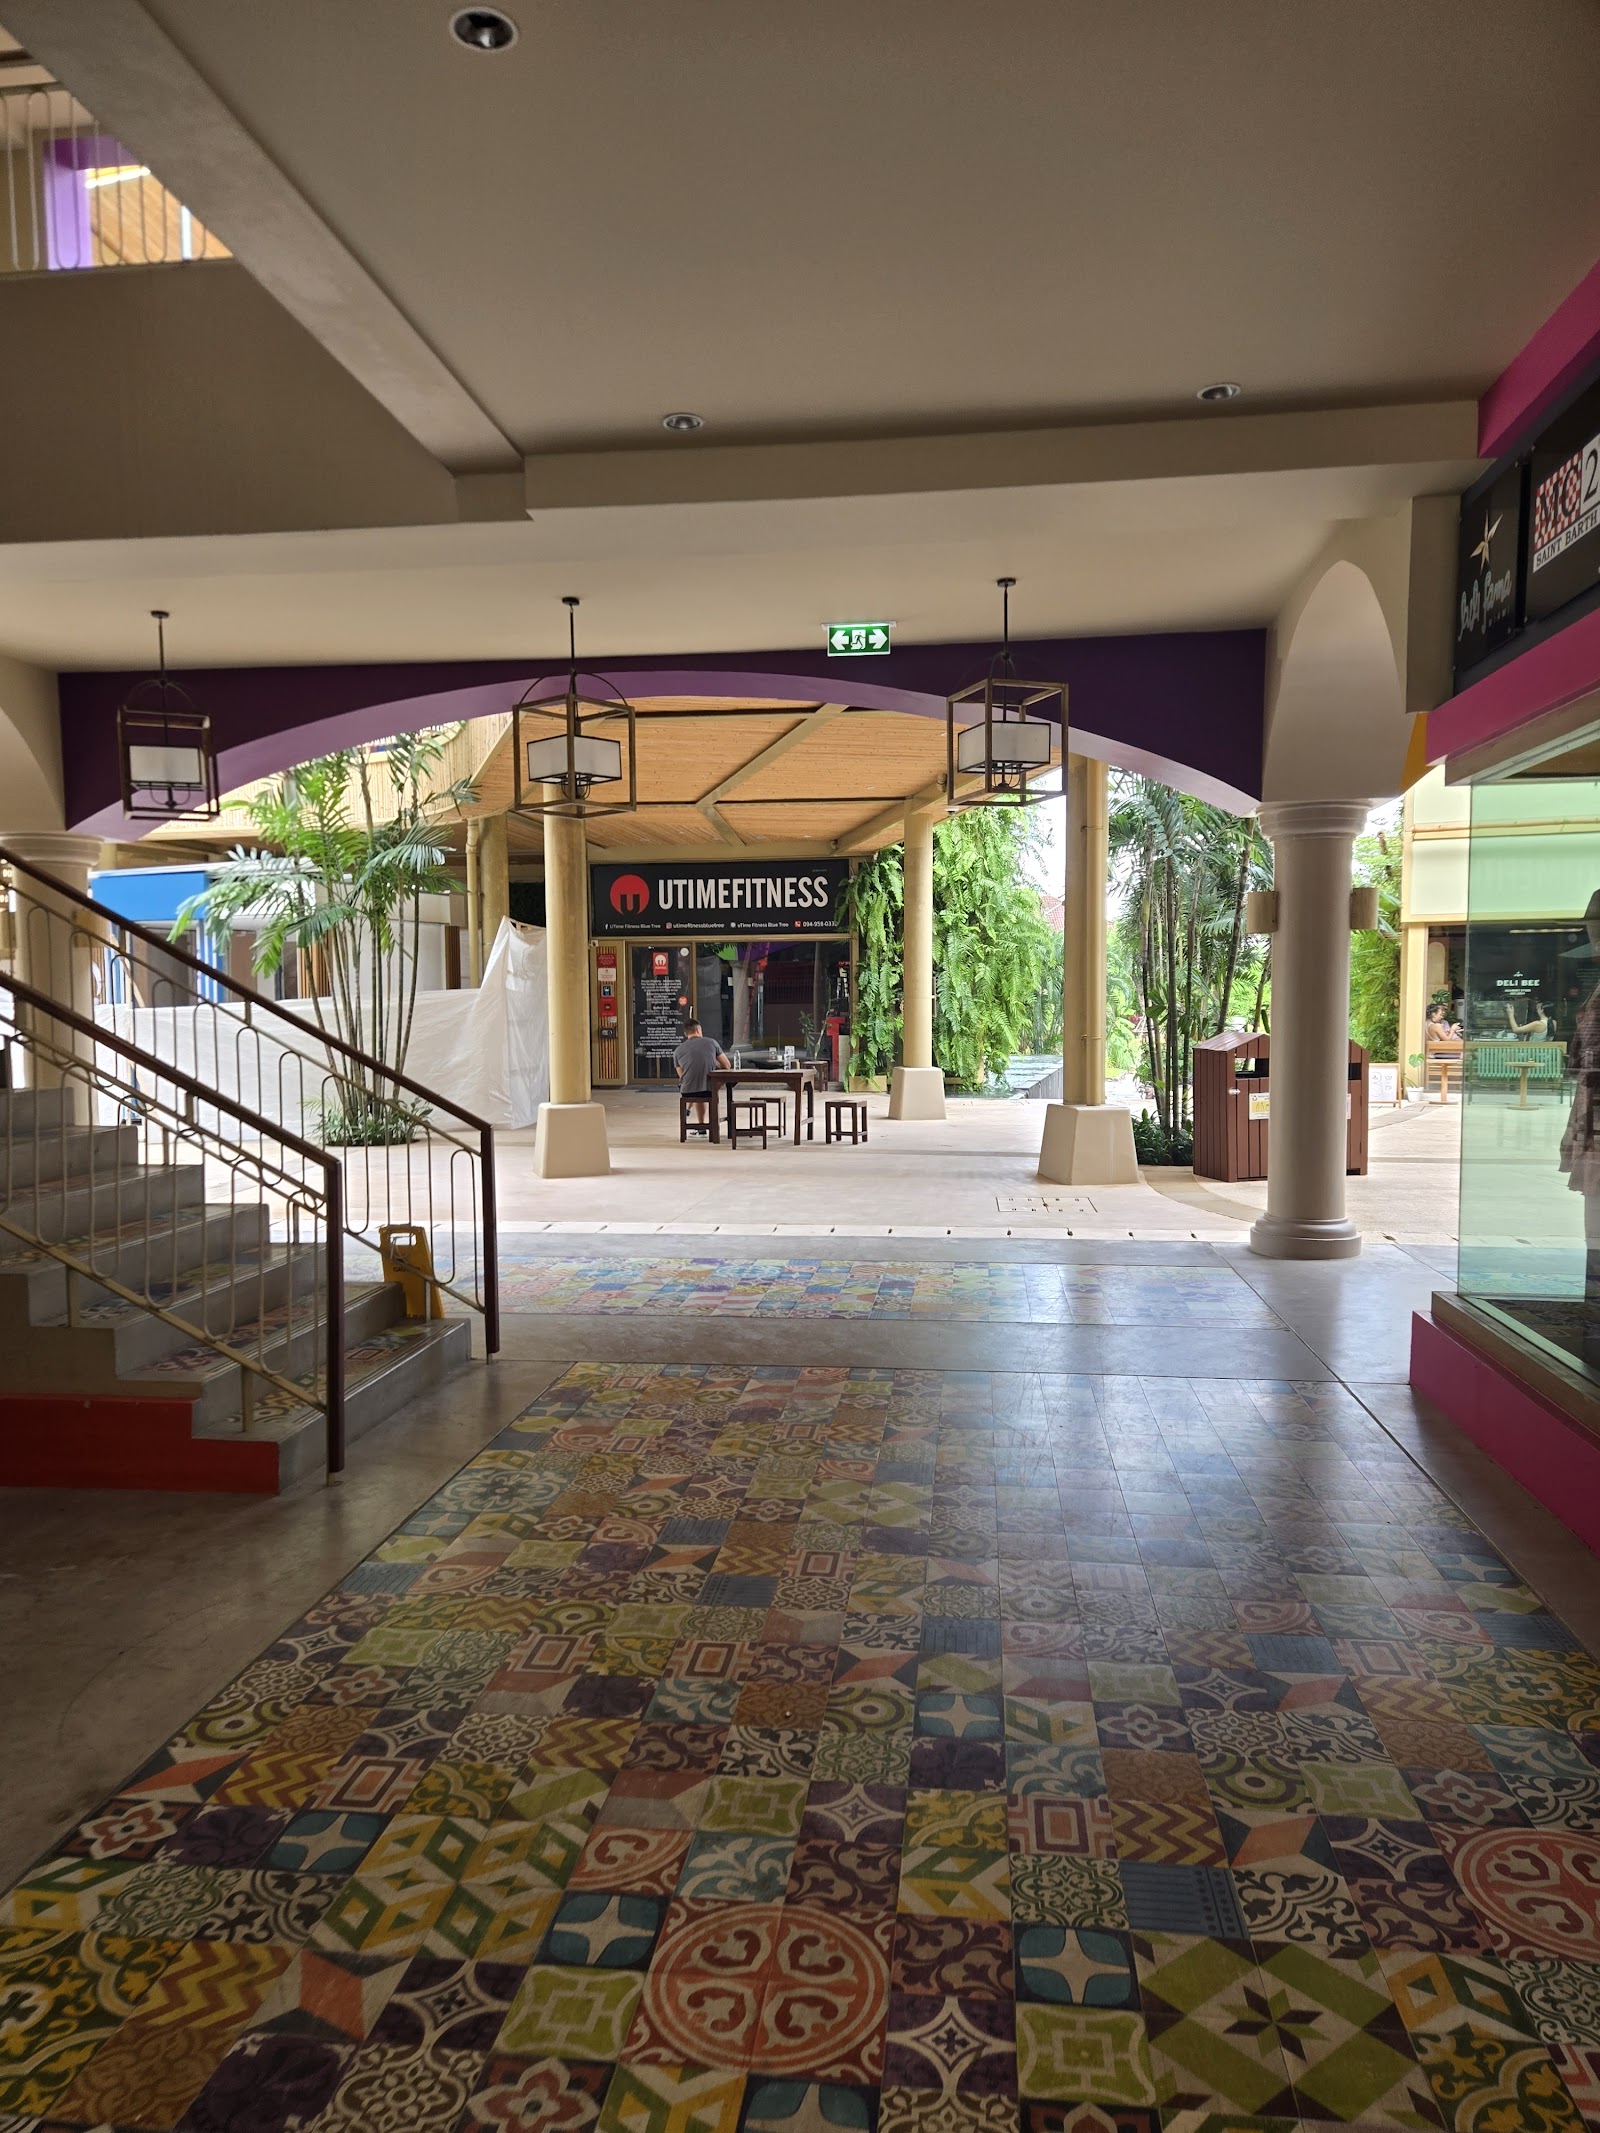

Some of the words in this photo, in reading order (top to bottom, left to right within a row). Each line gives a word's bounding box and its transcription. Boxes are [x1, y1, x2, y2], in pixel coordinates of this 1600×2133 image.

[1536, 537, 1562, 568] SAINT
[1565, 510, 1598, 547] BARTH
[658, 875, 829, 910] UTIMEFITNESS
[1496, 979, 1519, 987] DELI
[1521, 979, 1540, 987] BEE
